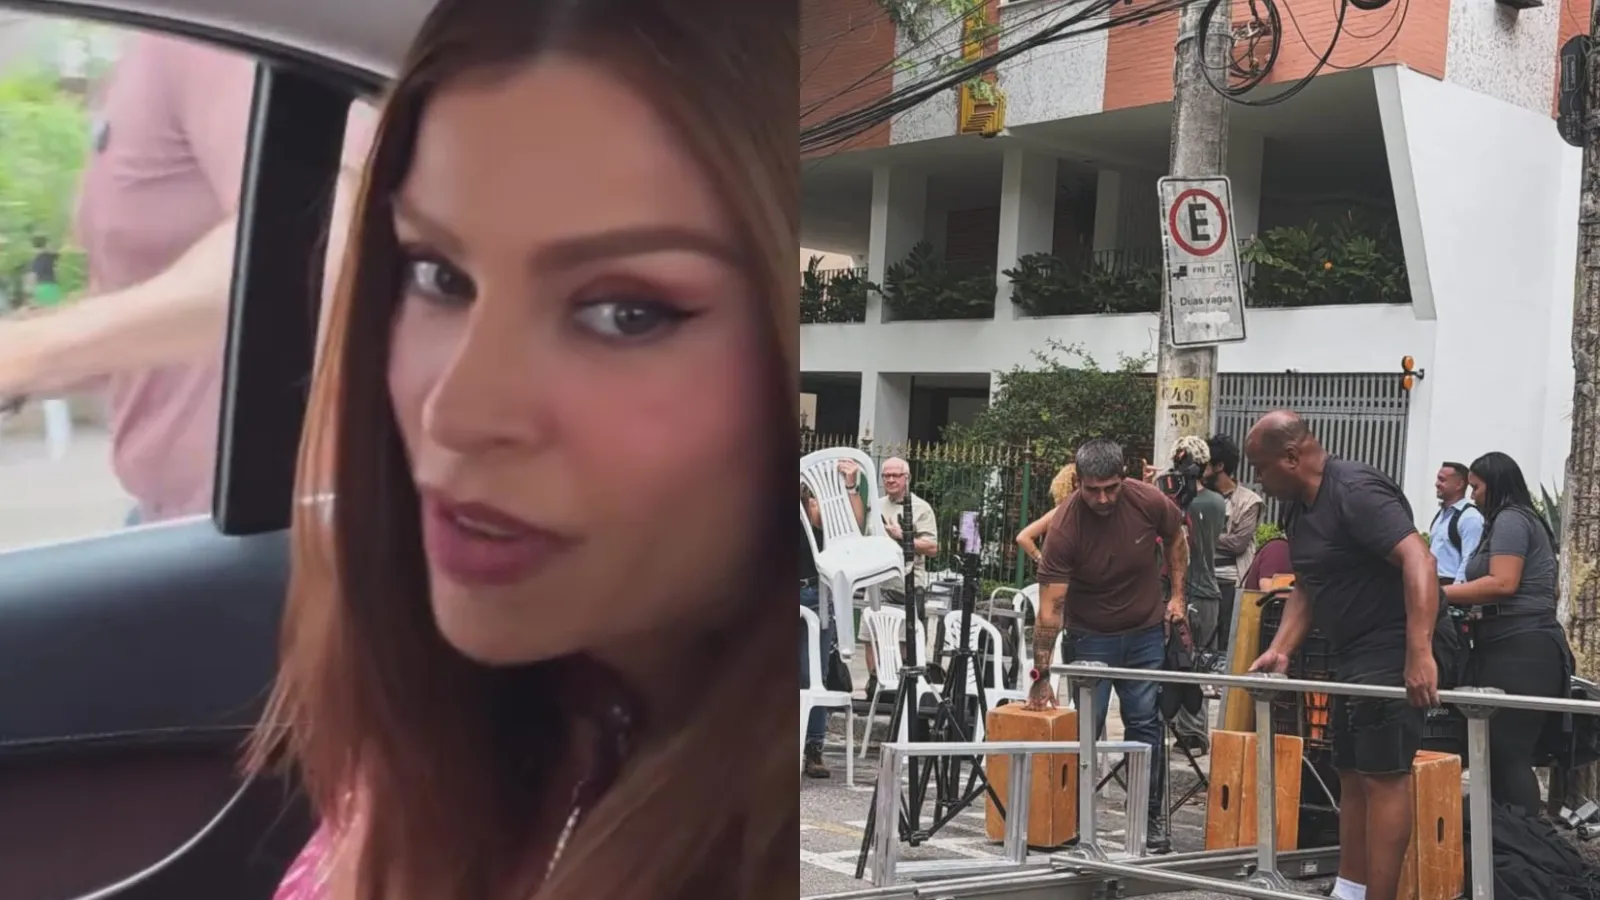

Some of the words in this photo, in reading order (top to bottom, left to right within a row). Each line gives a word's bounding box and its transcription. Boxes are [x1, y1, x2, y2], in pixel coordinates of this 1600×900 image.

[1188, 203, 1211, 241] E
[1180, 296, 1204, 306] Duas
[1205, 295, 1233, 306] vagas
[1170, 412, 1190, 428] 39
